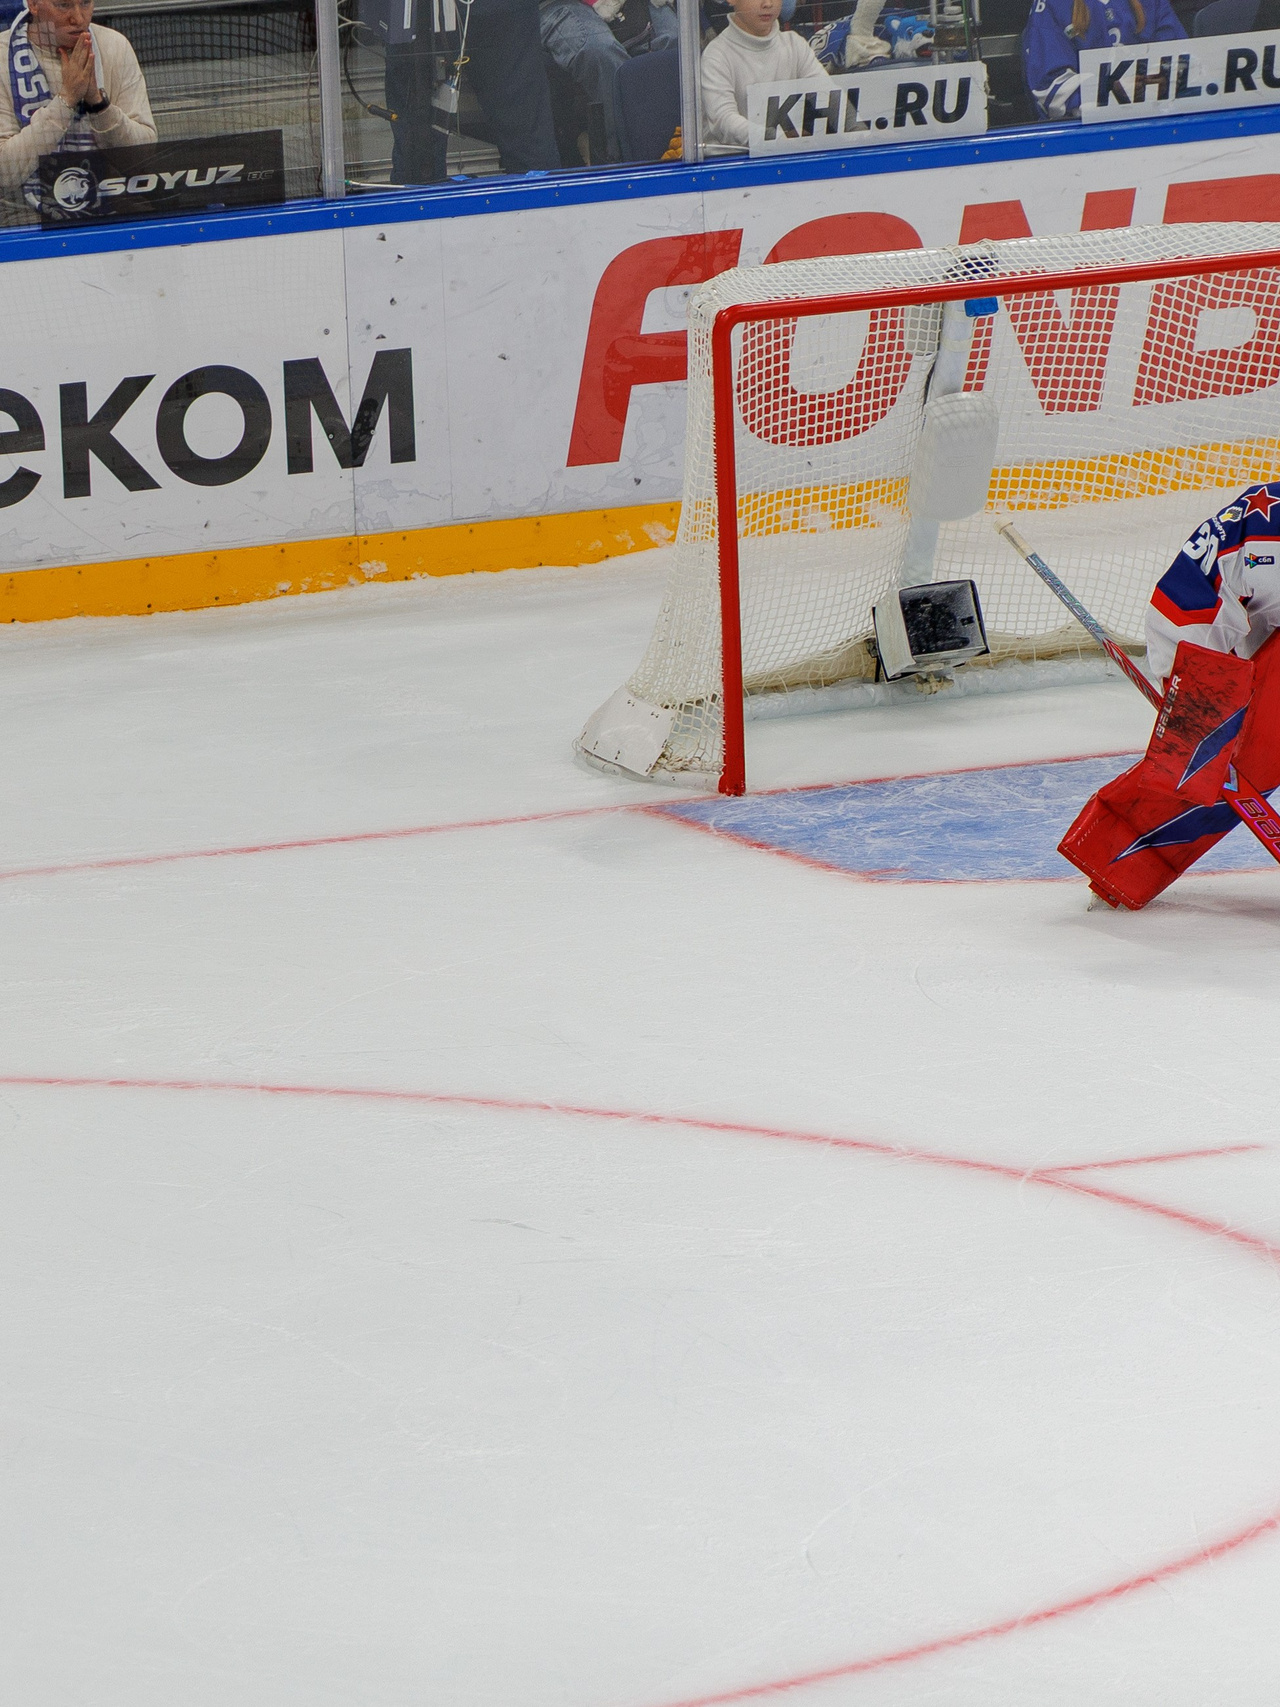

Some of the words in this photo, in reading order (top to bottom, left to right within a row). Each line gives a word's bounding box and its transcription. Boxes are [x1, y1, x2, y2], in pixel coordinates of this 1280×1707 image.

[764, 77, 971, 141] KHL.RU
[97, 164, 245, 197] SOYUZ
[1182, 522, 1219, 576] 30
